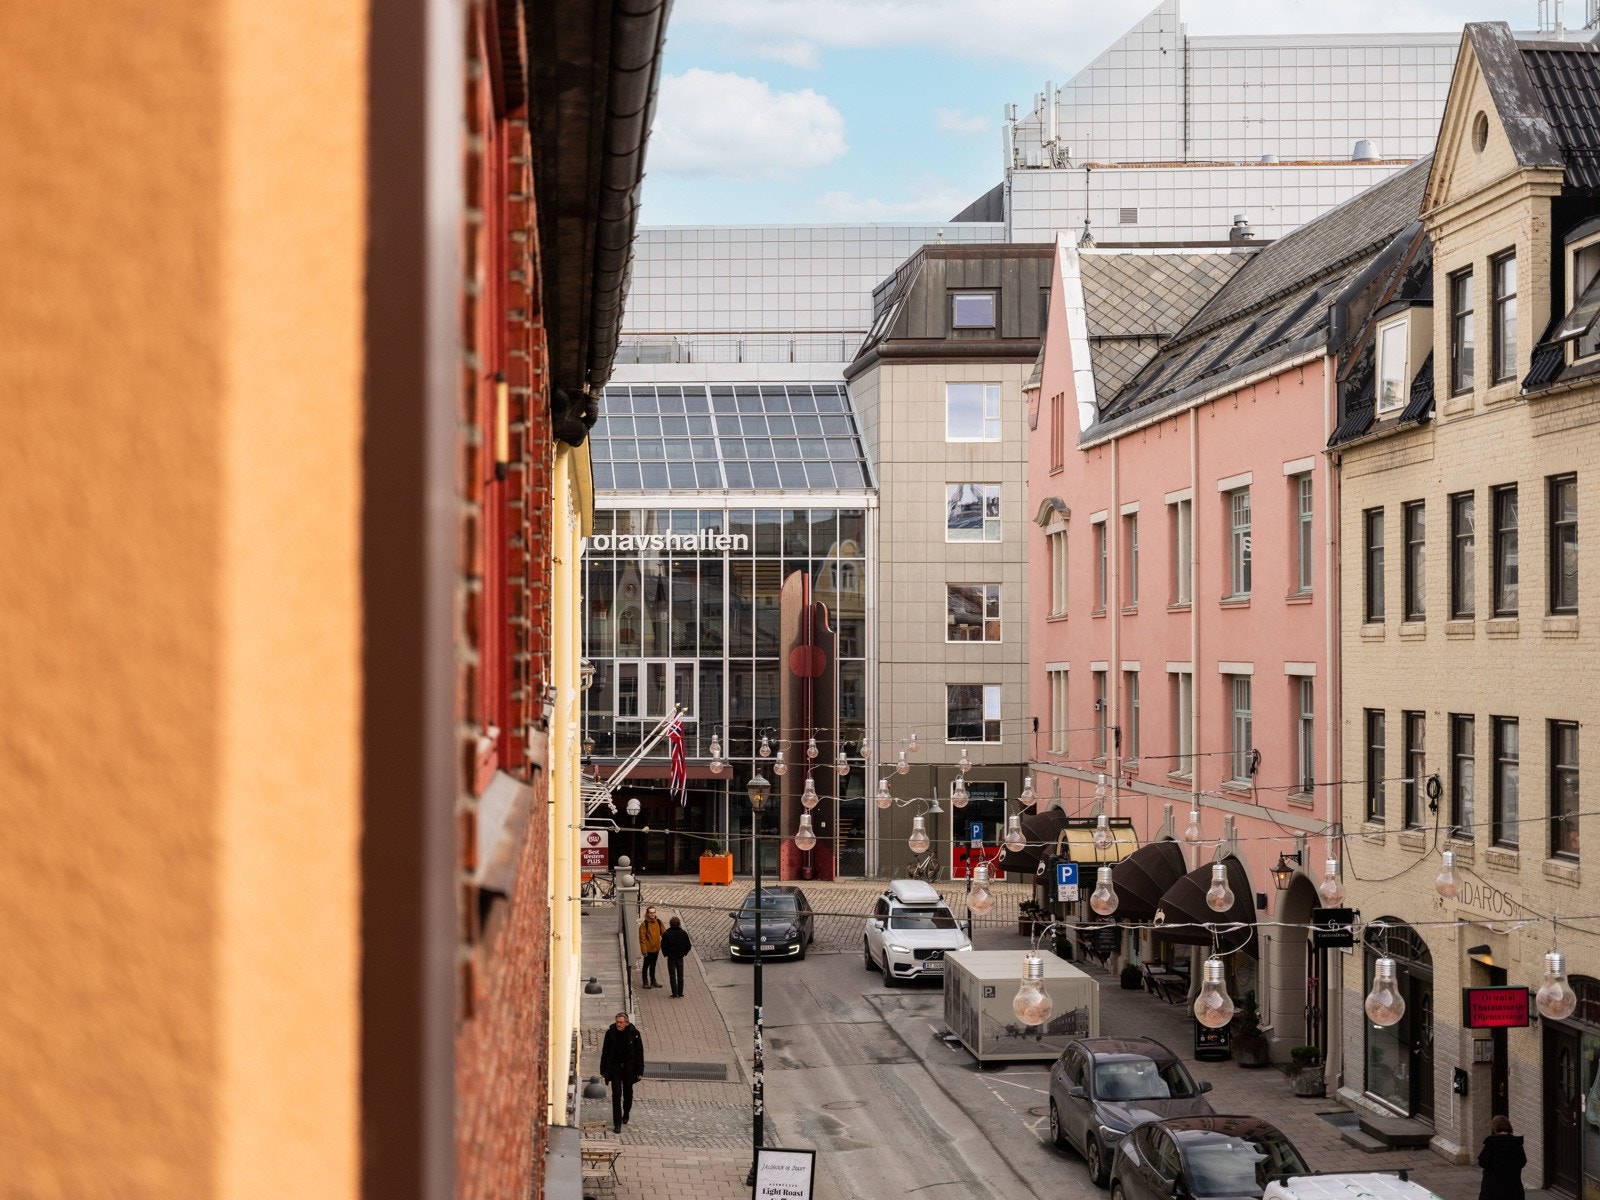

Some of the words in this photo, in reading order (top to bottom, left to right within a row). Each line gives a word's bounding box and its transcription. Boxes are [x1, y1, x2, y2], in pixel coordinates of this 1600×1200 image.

[593, 528, 749, 551] olavshallen
[973, 825, 980, 838] P
[1061, 866, 1073, 883] P
[762, 1188, 781, 1196] Light
[783, 1188, 803, 1197] Roast
